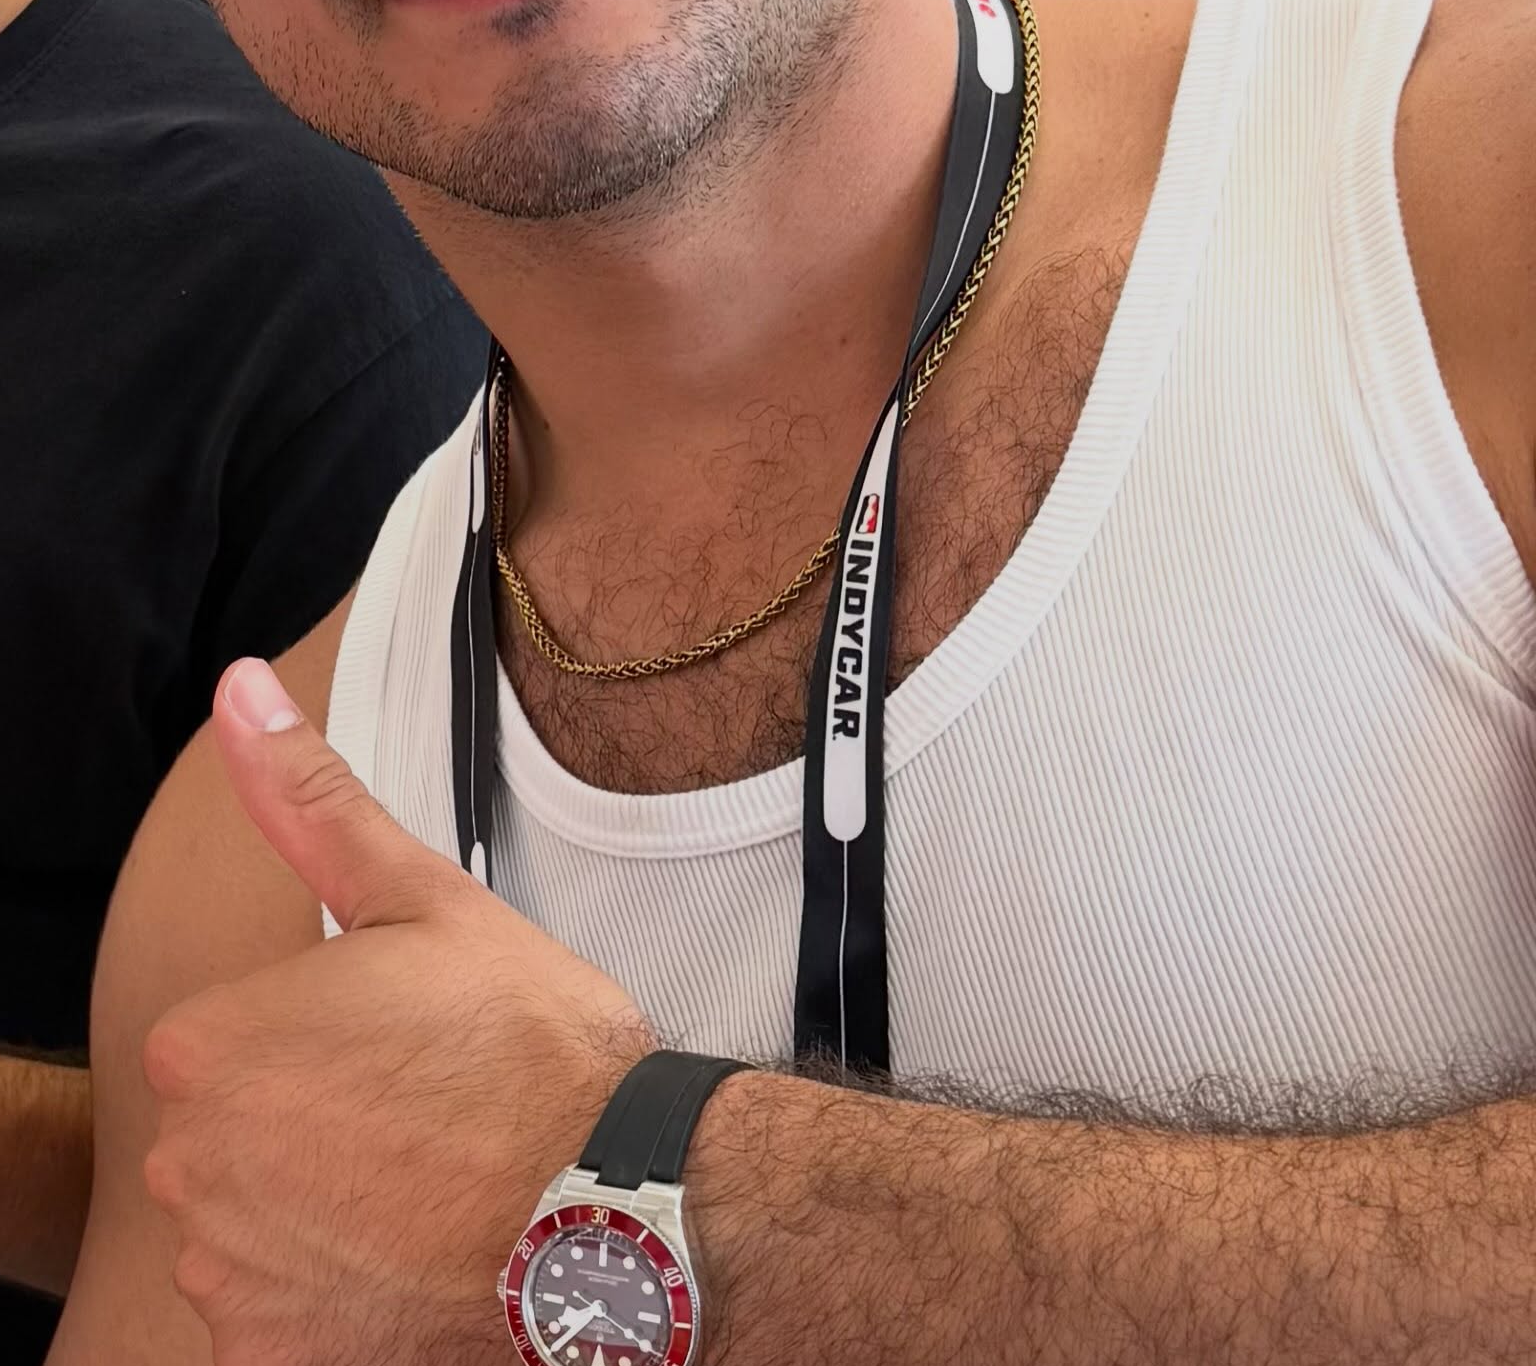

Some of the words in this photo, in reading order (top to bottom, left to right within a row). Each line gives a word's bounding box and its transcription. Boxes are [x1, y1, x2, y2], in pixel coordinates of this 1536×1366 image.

[833, 540, 873, 739] INDYCAR
[591, 1207, 610, 1224] 30
[517, 1238, 535, 1261] 20
[663, 1266, 684, 1288] 40
